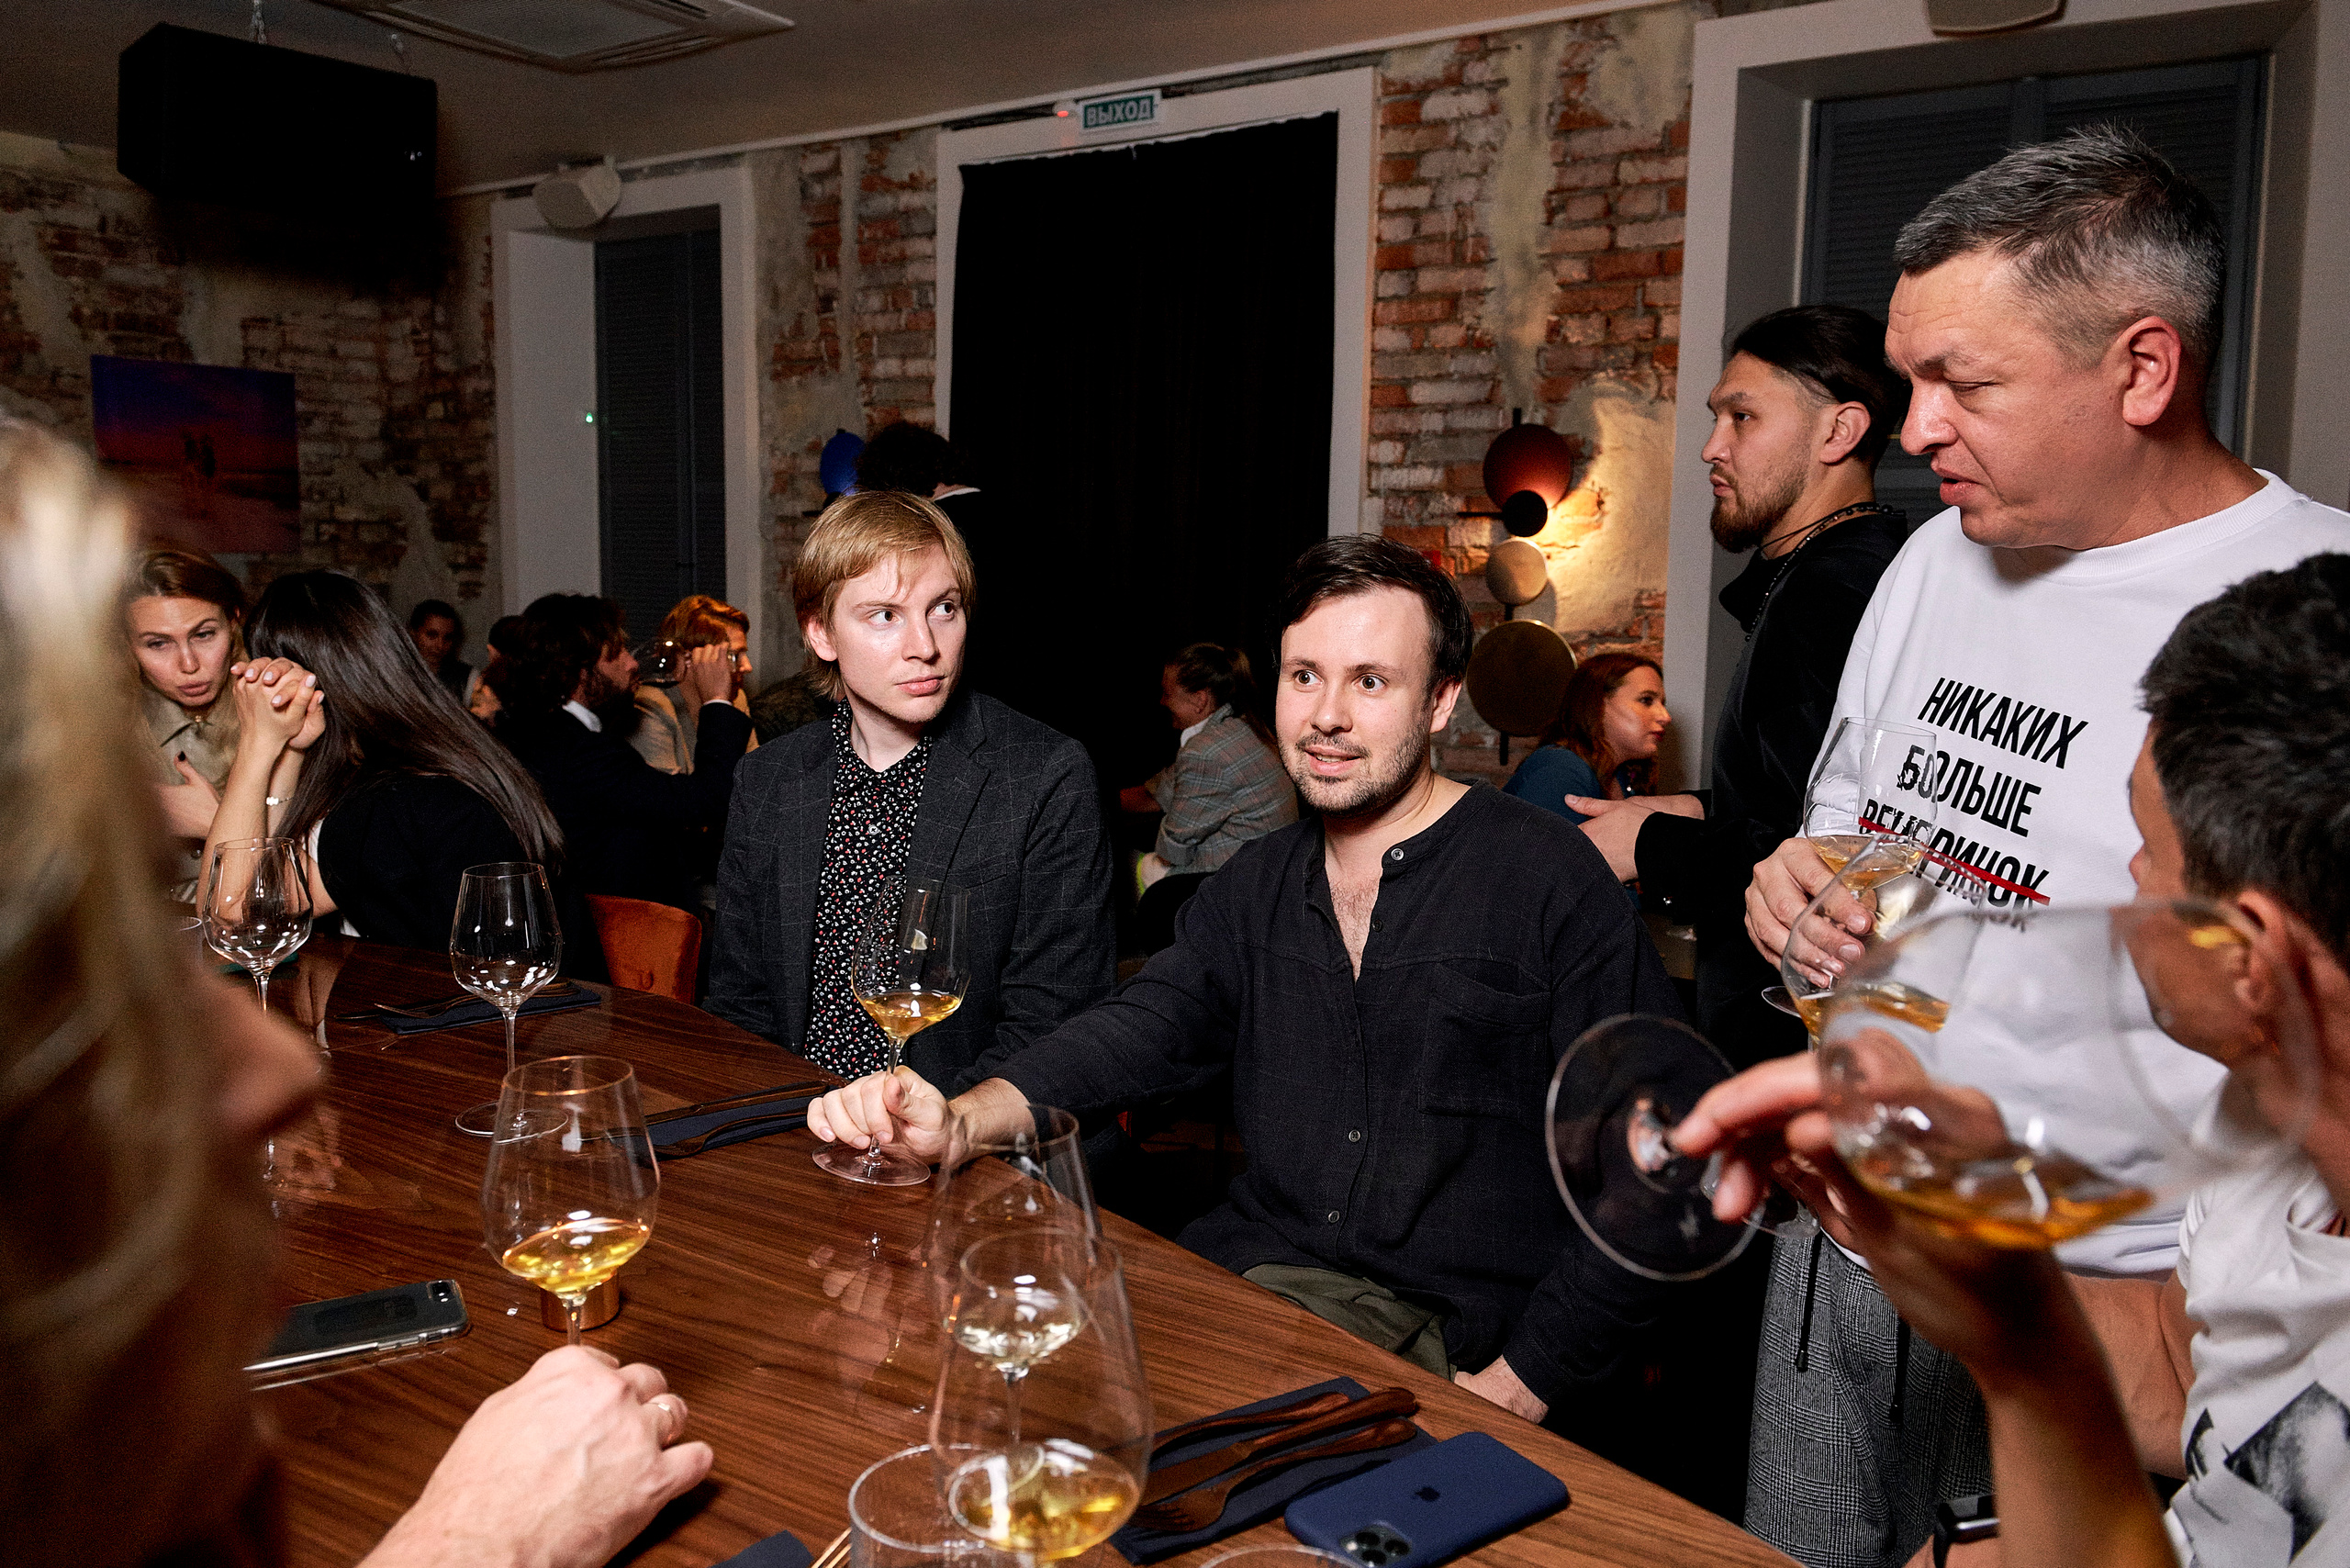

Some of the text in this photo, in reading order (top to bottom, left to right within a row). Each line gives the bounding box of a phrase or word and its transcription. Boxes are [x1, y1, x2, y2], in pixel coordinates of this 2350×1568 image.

[1087, 98, 1151, 126] ВЫХОД
[1918, 677, 2089, 769] НИКАКИХ
[1897, 744, 2042, 838] БОЛЬШЕ
